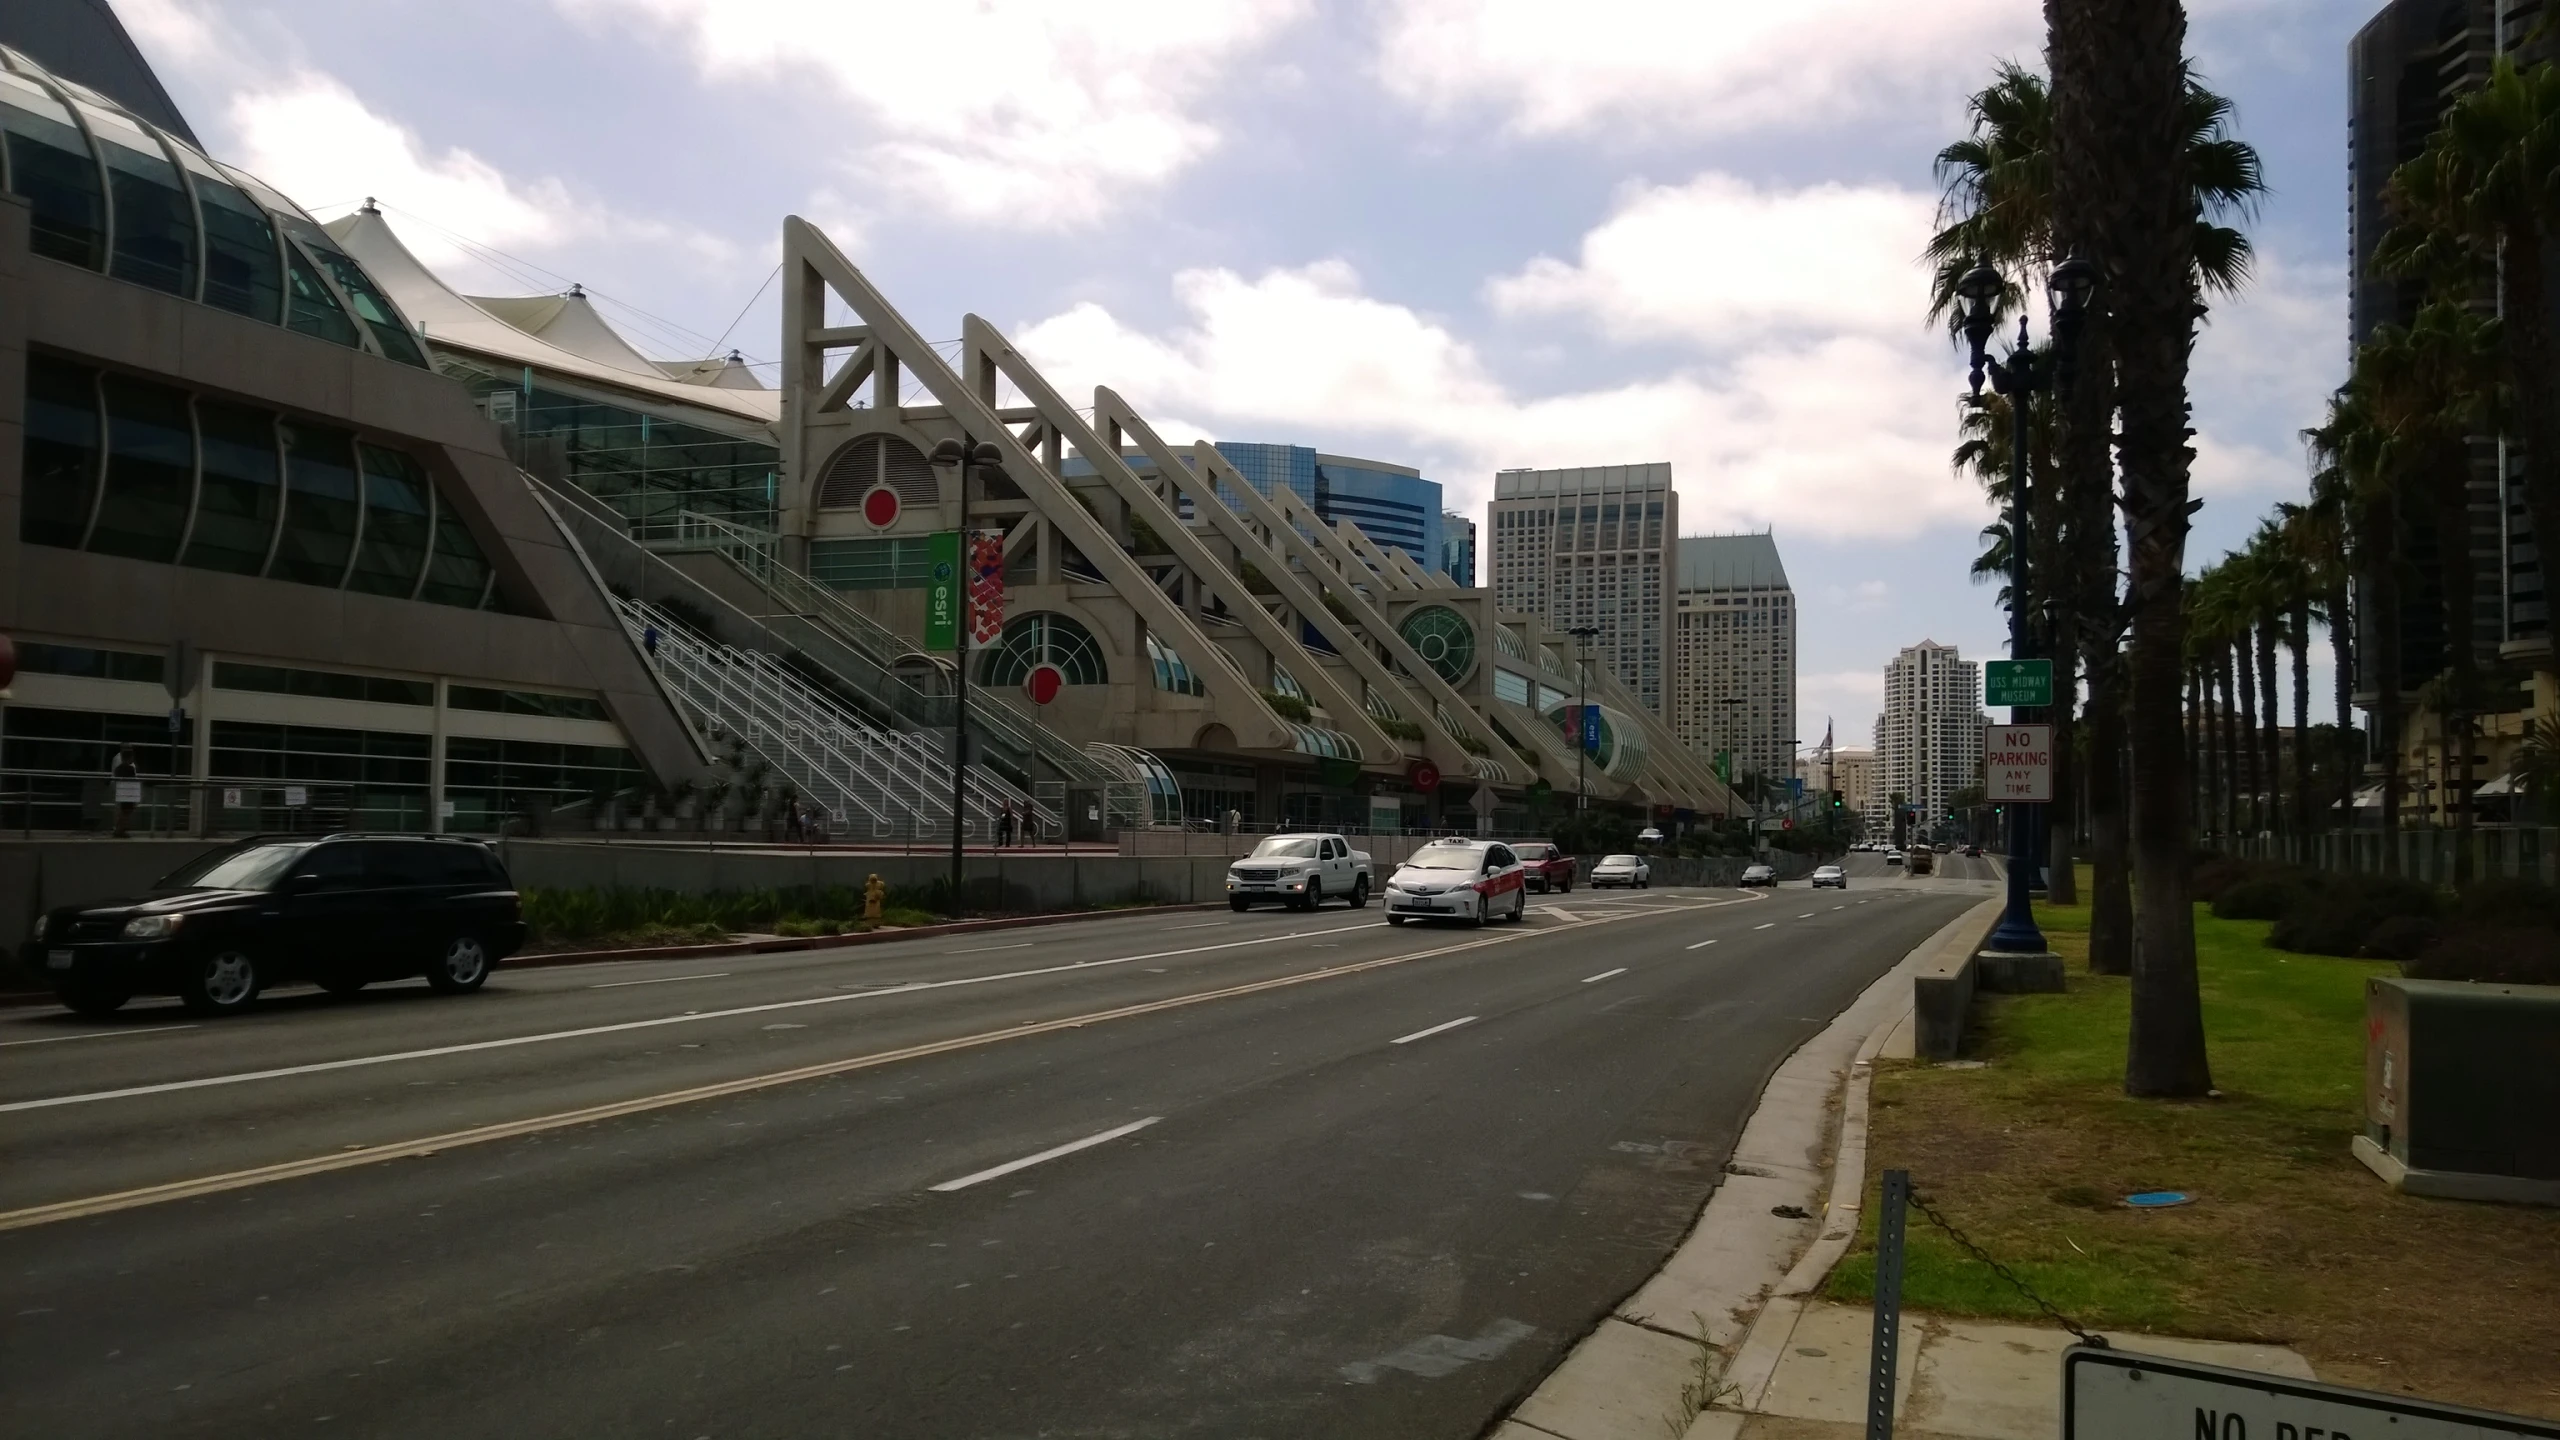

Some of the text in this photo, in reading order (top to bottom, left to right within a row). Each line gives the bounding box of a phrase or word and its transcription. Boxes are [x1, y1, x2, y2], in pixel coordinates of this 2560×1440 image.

[935, 586, 951, 625] esri
[1990, 675, 2047, 689] USS MIDWAY
[2000, 690, 2036, 702] MUSEUM
[1588, 724, 1597, 741] esri
[2006, 732, 2030, 747] NO
[1989, 751, 2048, 766] PARKING
[1417, 768, 1432, 786] C
[2005, 770, 2031, 780] ANY
[2005, 784, 2032, 794] TIME
[2195, 1407, 2246, 1440] NO
